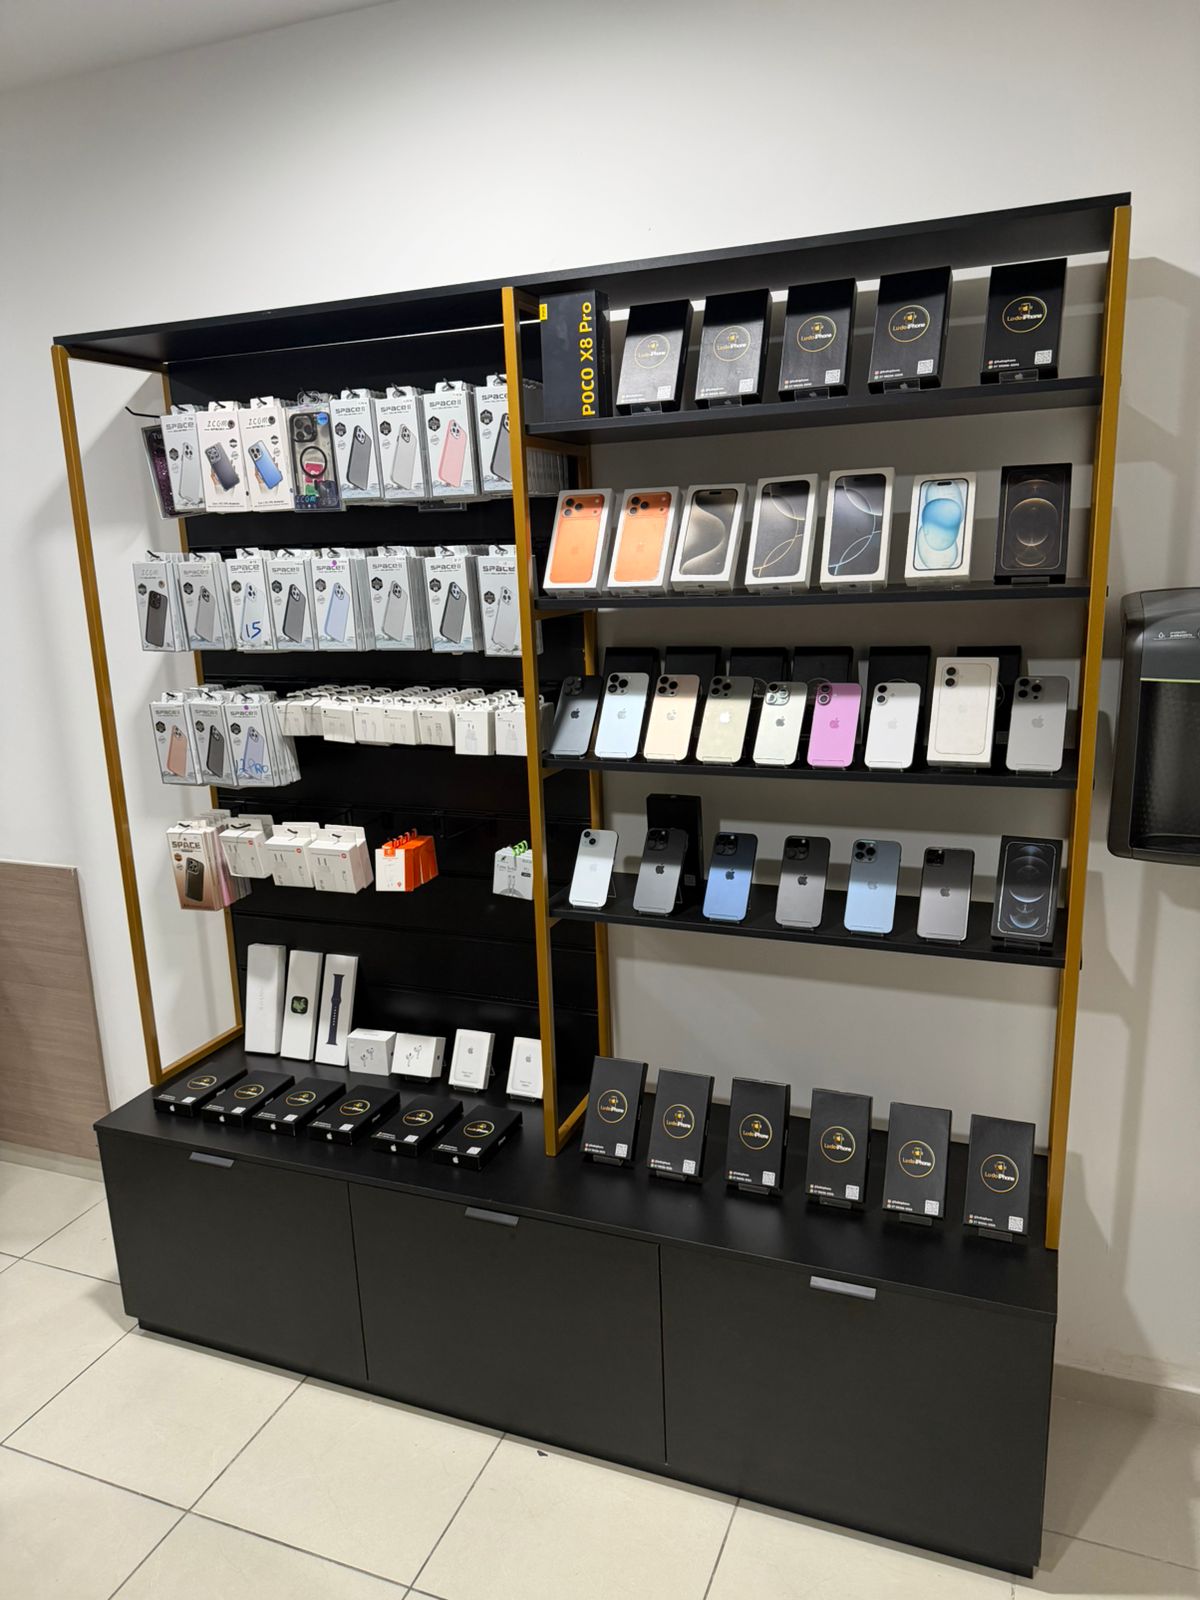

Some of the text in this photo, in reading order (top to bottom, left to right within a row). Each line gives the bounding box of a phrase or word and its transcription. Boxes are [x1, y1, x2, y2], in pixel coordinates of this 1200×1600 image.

[578, 301, 596, 417] POCO X8 Pro
[246, 621, 262, 639] 15
[171, 841, 201, 850] SPACE
